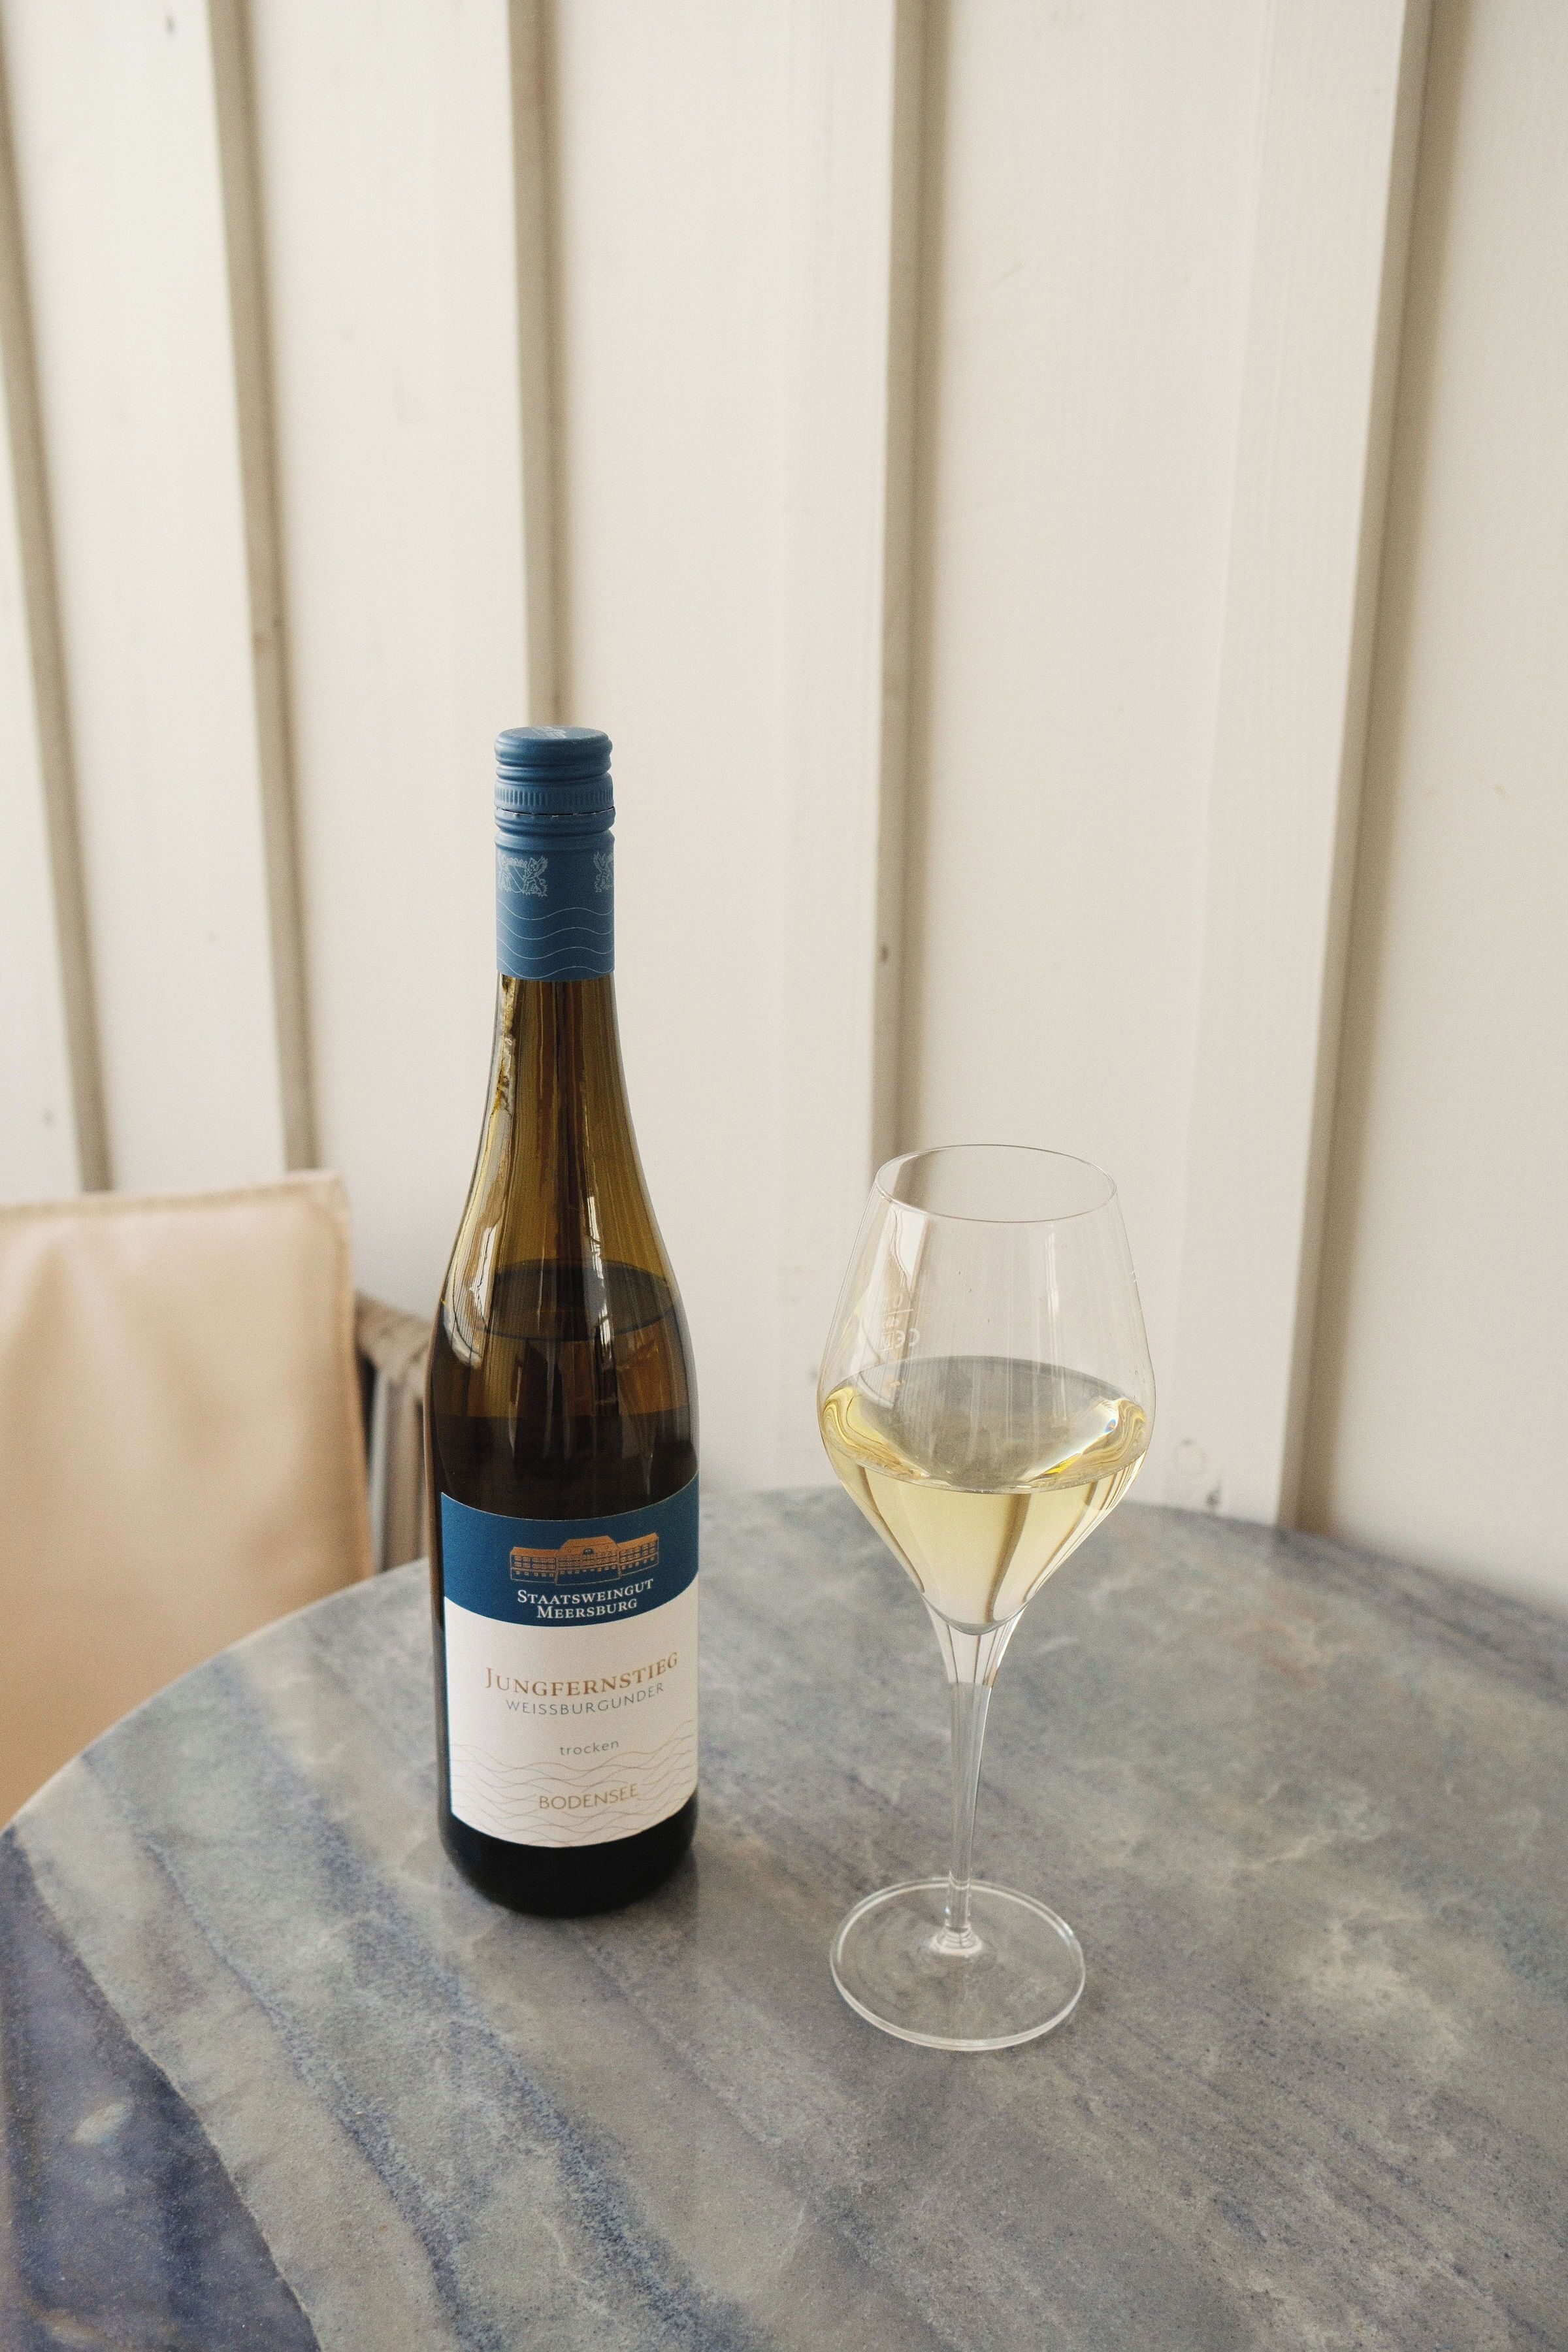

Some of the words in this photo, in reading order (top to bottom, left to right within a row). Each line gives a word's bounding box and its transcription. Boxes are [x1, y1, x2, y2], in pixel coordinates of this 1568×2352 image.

[517, 1578, 654, 1605] STAATSWEINGUT
[536, 1598, 638, 1619] MEERSBURG
[485, 1652, 678, 1697] JUNGFERNSTIEG
[506, 1682, 664, 1716] WEISSBURGUNDER
[559, 1740, 619, 1756] trocken
[539, 1784, 638, 1810] BODENSEE
